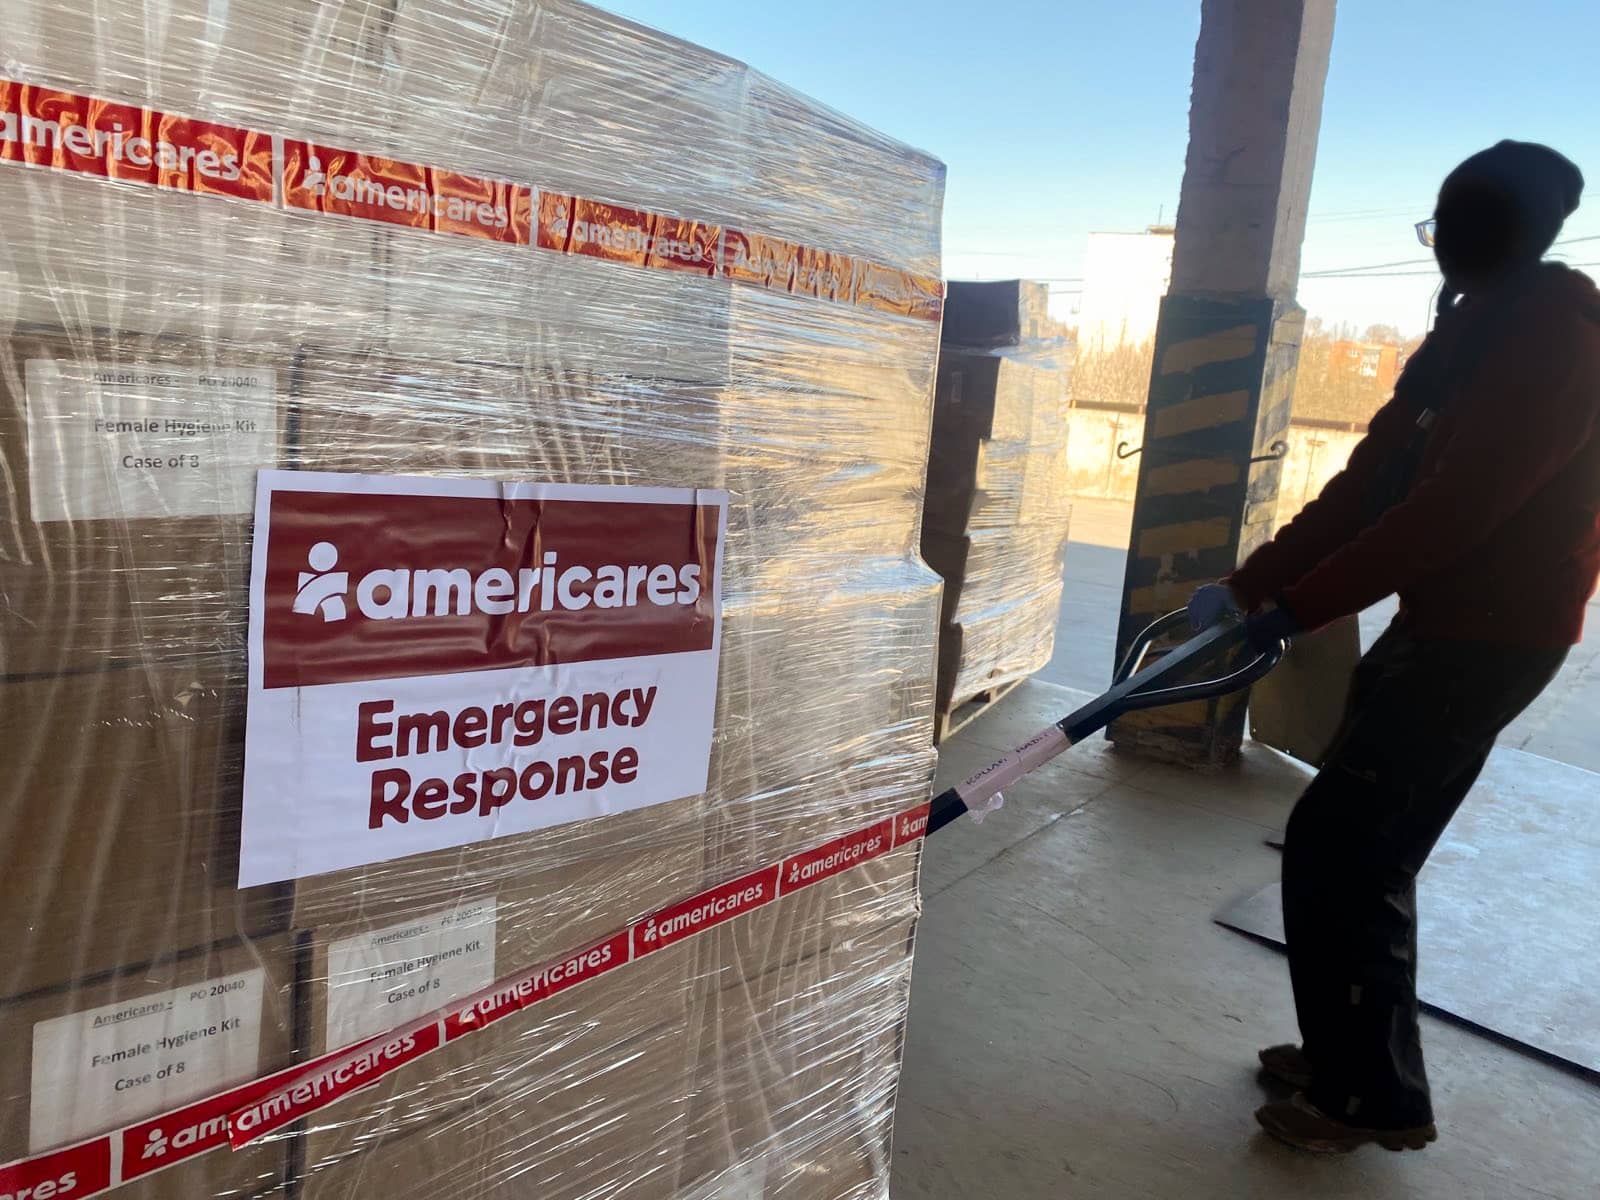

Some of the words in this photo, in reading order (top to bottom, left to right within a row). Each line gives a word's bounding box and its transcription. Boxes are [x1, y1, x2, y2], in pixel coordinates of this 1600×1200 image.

[0, 111, 241, 181] americares
[94, 418, 159, 433] Female
[165, 419, 231, 436] Hygiene
[236, 419, 257, 434] Kit
[122, 455, 163, 469] Case
[168, 454, 185, 469] of
[191, 454, 200, 468] 8
[356, 552, 701, 620] americares
[356, 685, 658, 763] Emergency
[368, 746, 639, 830] Response
[236, 1033, 416, 1131] americares
[478, 943, 612, 1015] americares
[659, 880, 763, 938] americares
[800, 833, 882, 881] americares
[370, 962, 414, 983] Female
[417, 946, 463, 969] Hygiene
[465, 939, 481, 953] Kit
[94, 1003, 164, 1026] Americares
[190, 990, 208, 1002] PO
[210, 979, 245, 997] 20040
[388, 988, 415, 1004] Case
[418, 980, 431, 994] of
[433, 978, 440, 989] 8
[92, 1042, 151, 1068] Female
[156, 1025, 217, 1049] Hygiene
[221, 1018, 241, 1032] Kit
[115, 1073, 151, 1091] Case
[157, 1063, 173, 1080] of
[176, 1061, 185, 1073] 8
